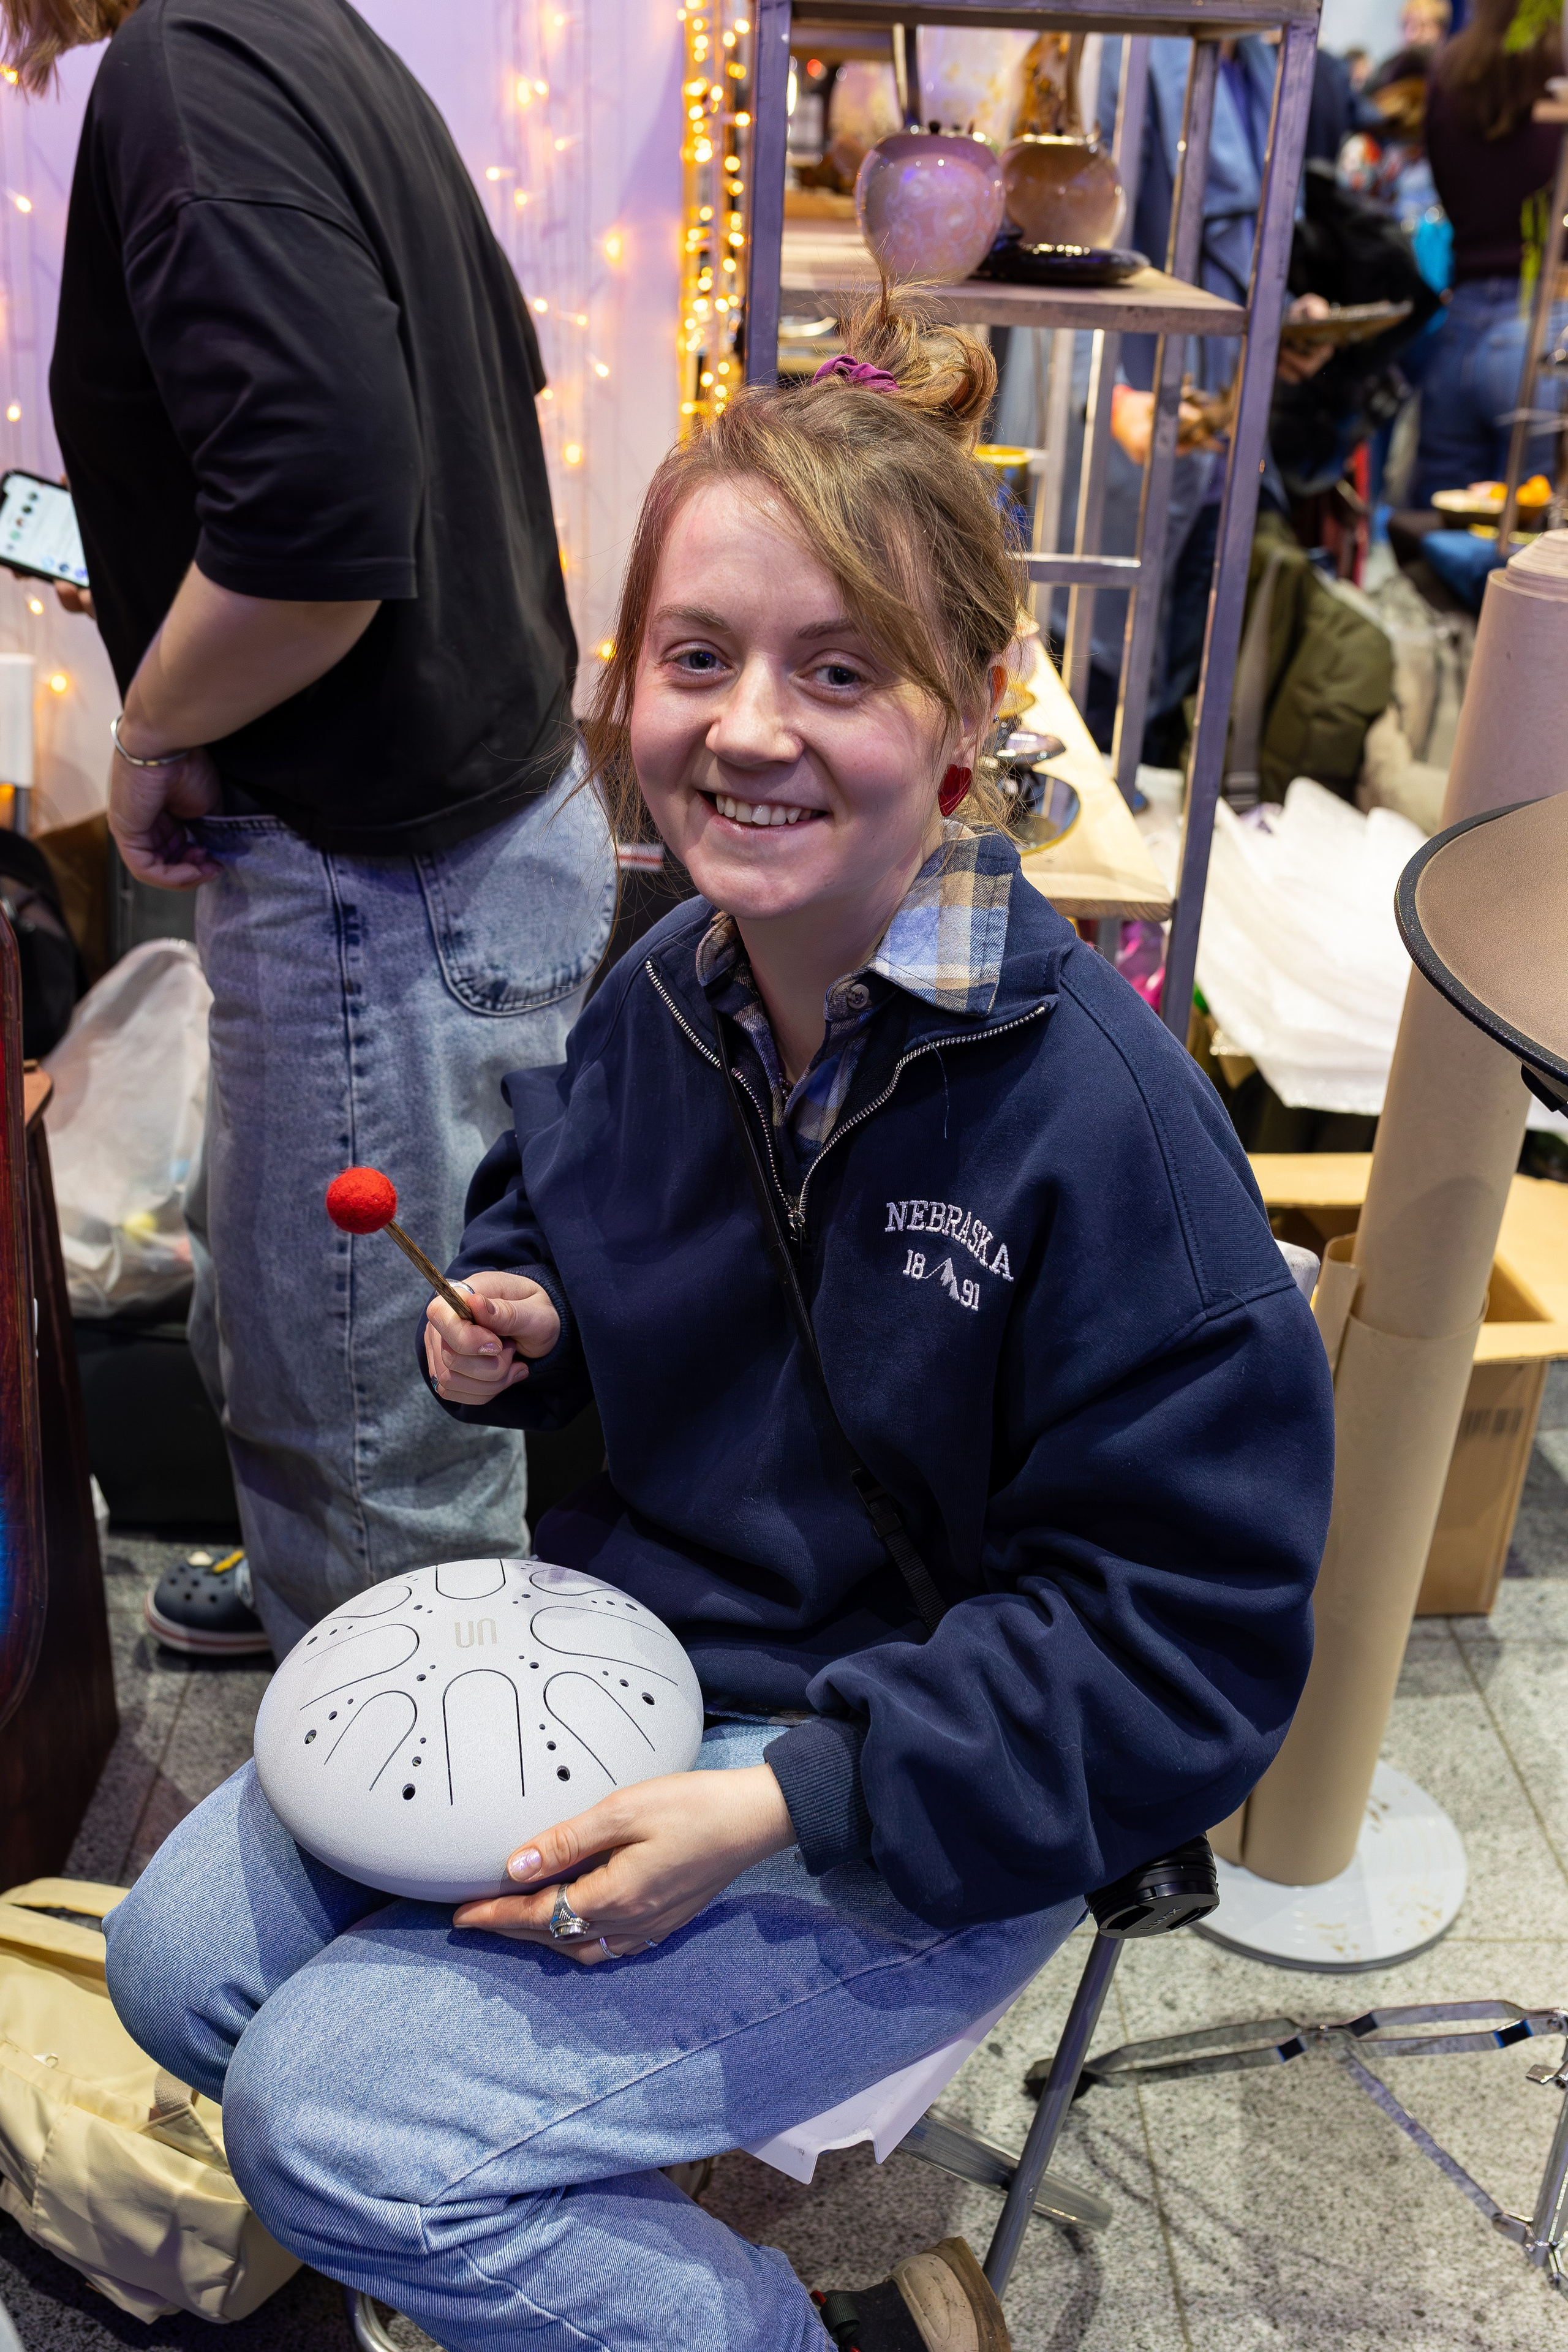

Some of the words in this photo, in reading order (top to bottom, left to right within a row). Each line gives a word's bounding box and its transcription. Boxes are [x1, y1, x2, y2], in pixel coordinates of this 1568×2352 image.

[884, 1200, 1014, 1282] NEBRASKA
[902, 1249, 926, 1280] 18
[960, 1278, 980, 1311] 91
[1139, 1907, 1182, 1931] LUMIX
